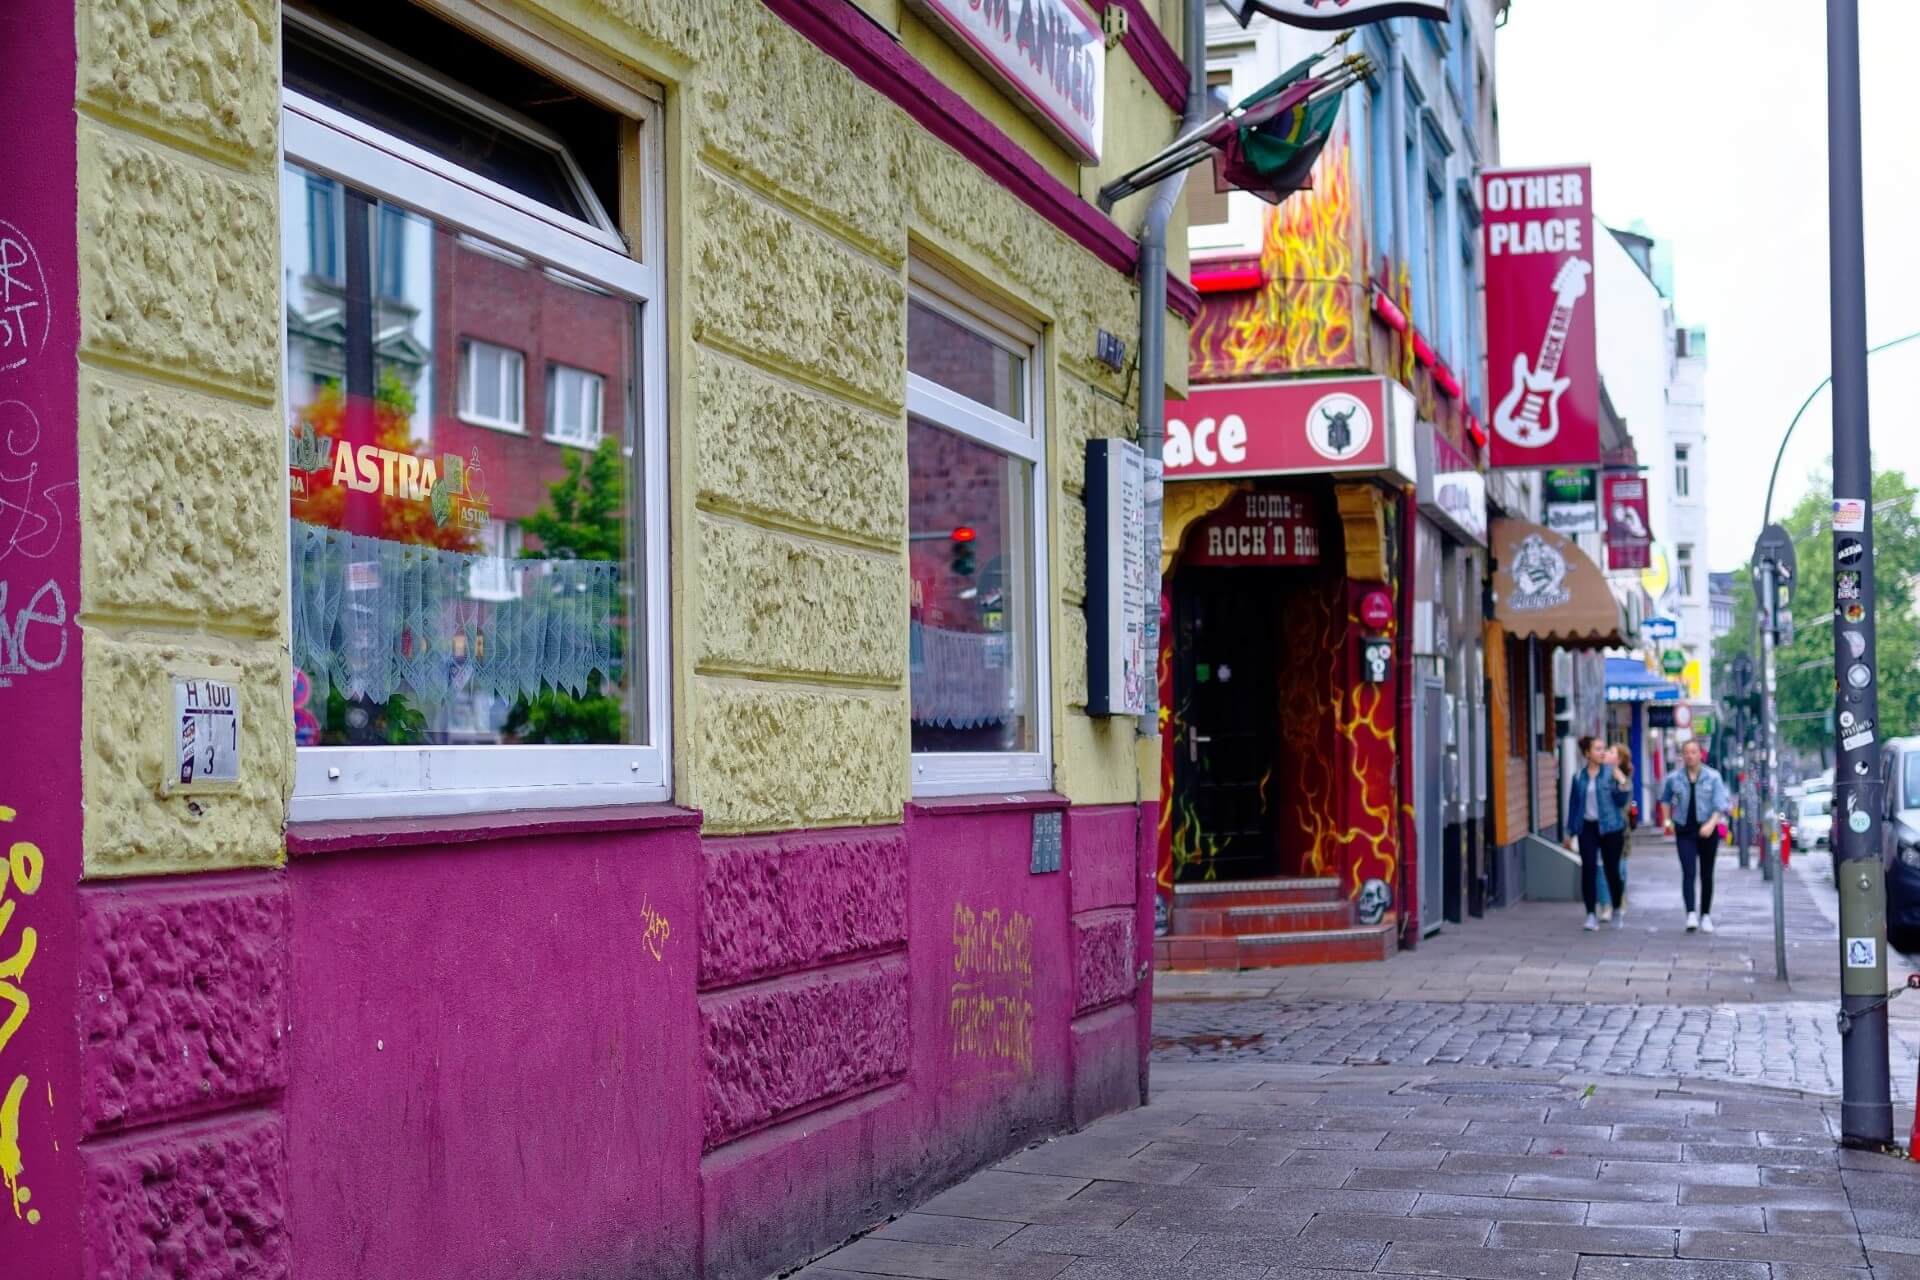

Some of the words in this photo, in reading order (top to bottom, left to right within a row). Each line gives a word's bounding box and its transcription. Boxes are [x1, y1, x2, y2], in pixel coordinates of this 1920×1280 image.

[1486, 174, 1583, 211] OTHER
[1489, 218, 1582, 255] PLACE
[332, 440, 437, 501] ASTRA
[203, 745, 215, 775] 3
